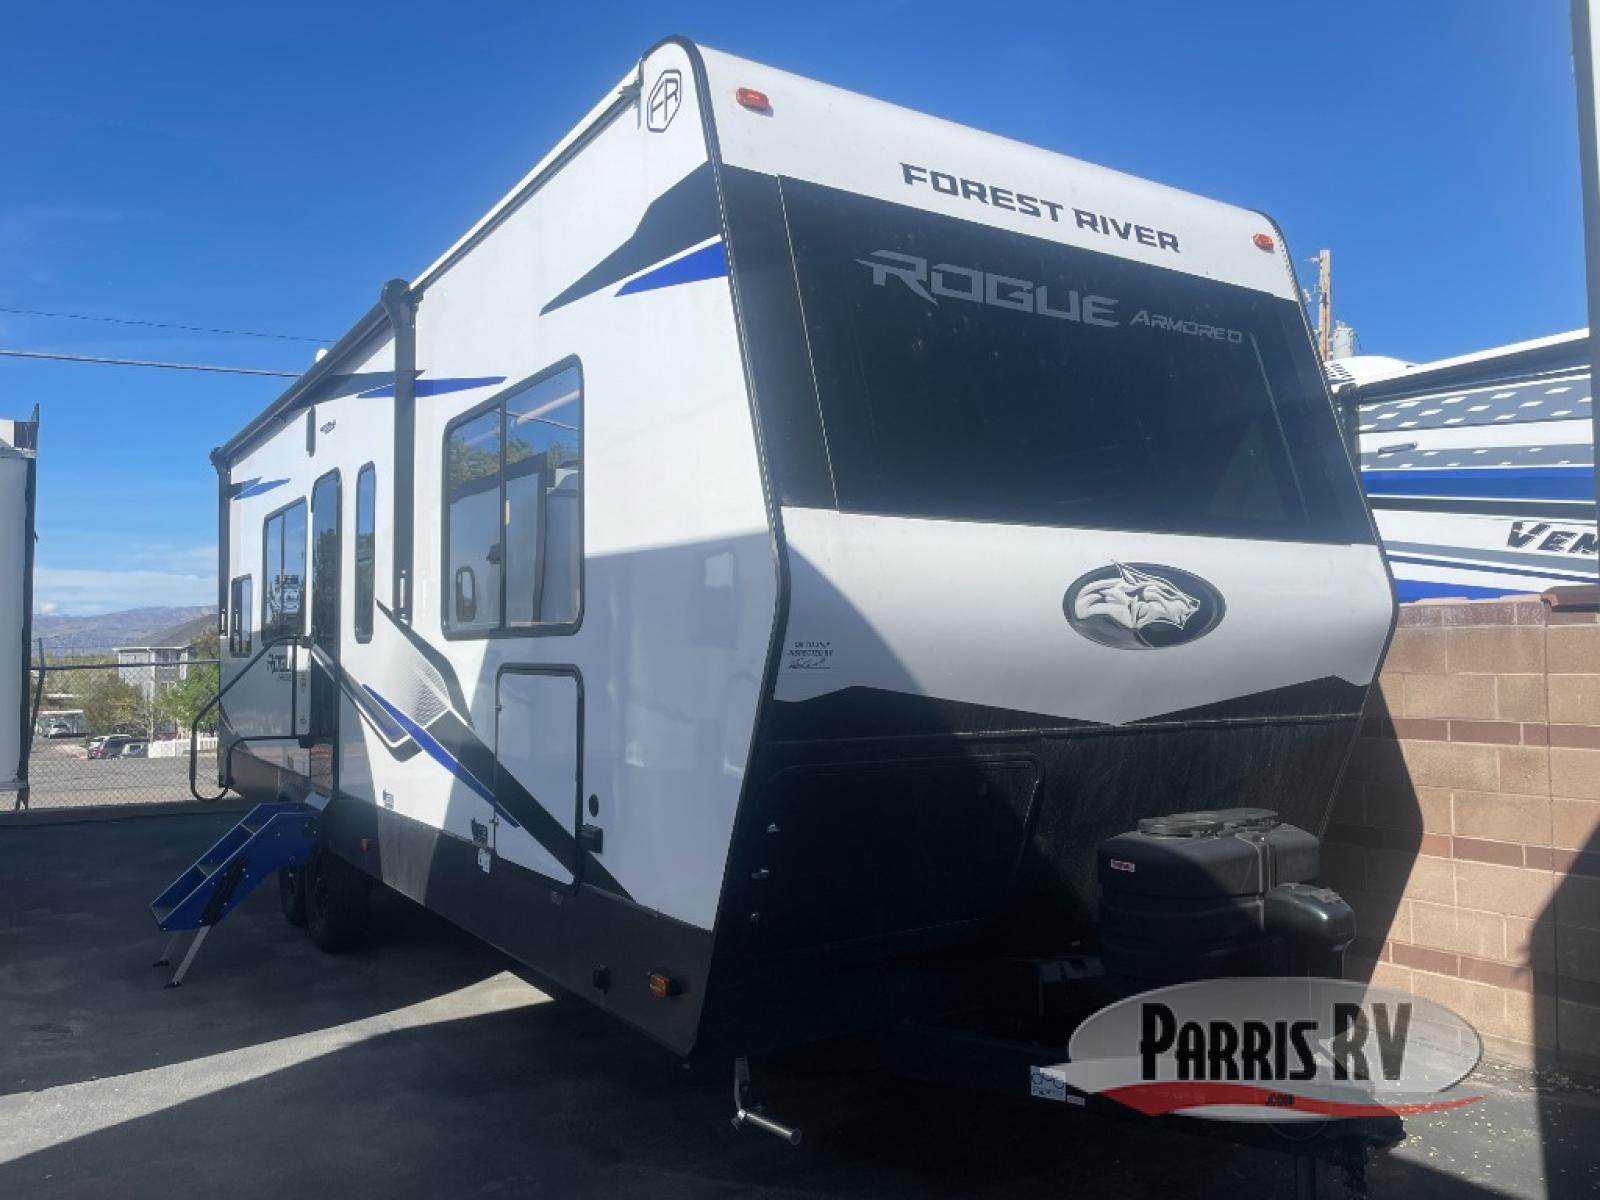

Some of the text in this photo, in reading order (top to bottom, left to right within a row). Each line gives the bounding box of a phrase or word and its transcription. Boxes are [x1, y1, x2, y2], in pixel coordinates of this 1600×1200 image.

[900, 163, 1180, 253] FOREST RIVER
[857, 250, 1243, 344] ROGUE ARMORED
